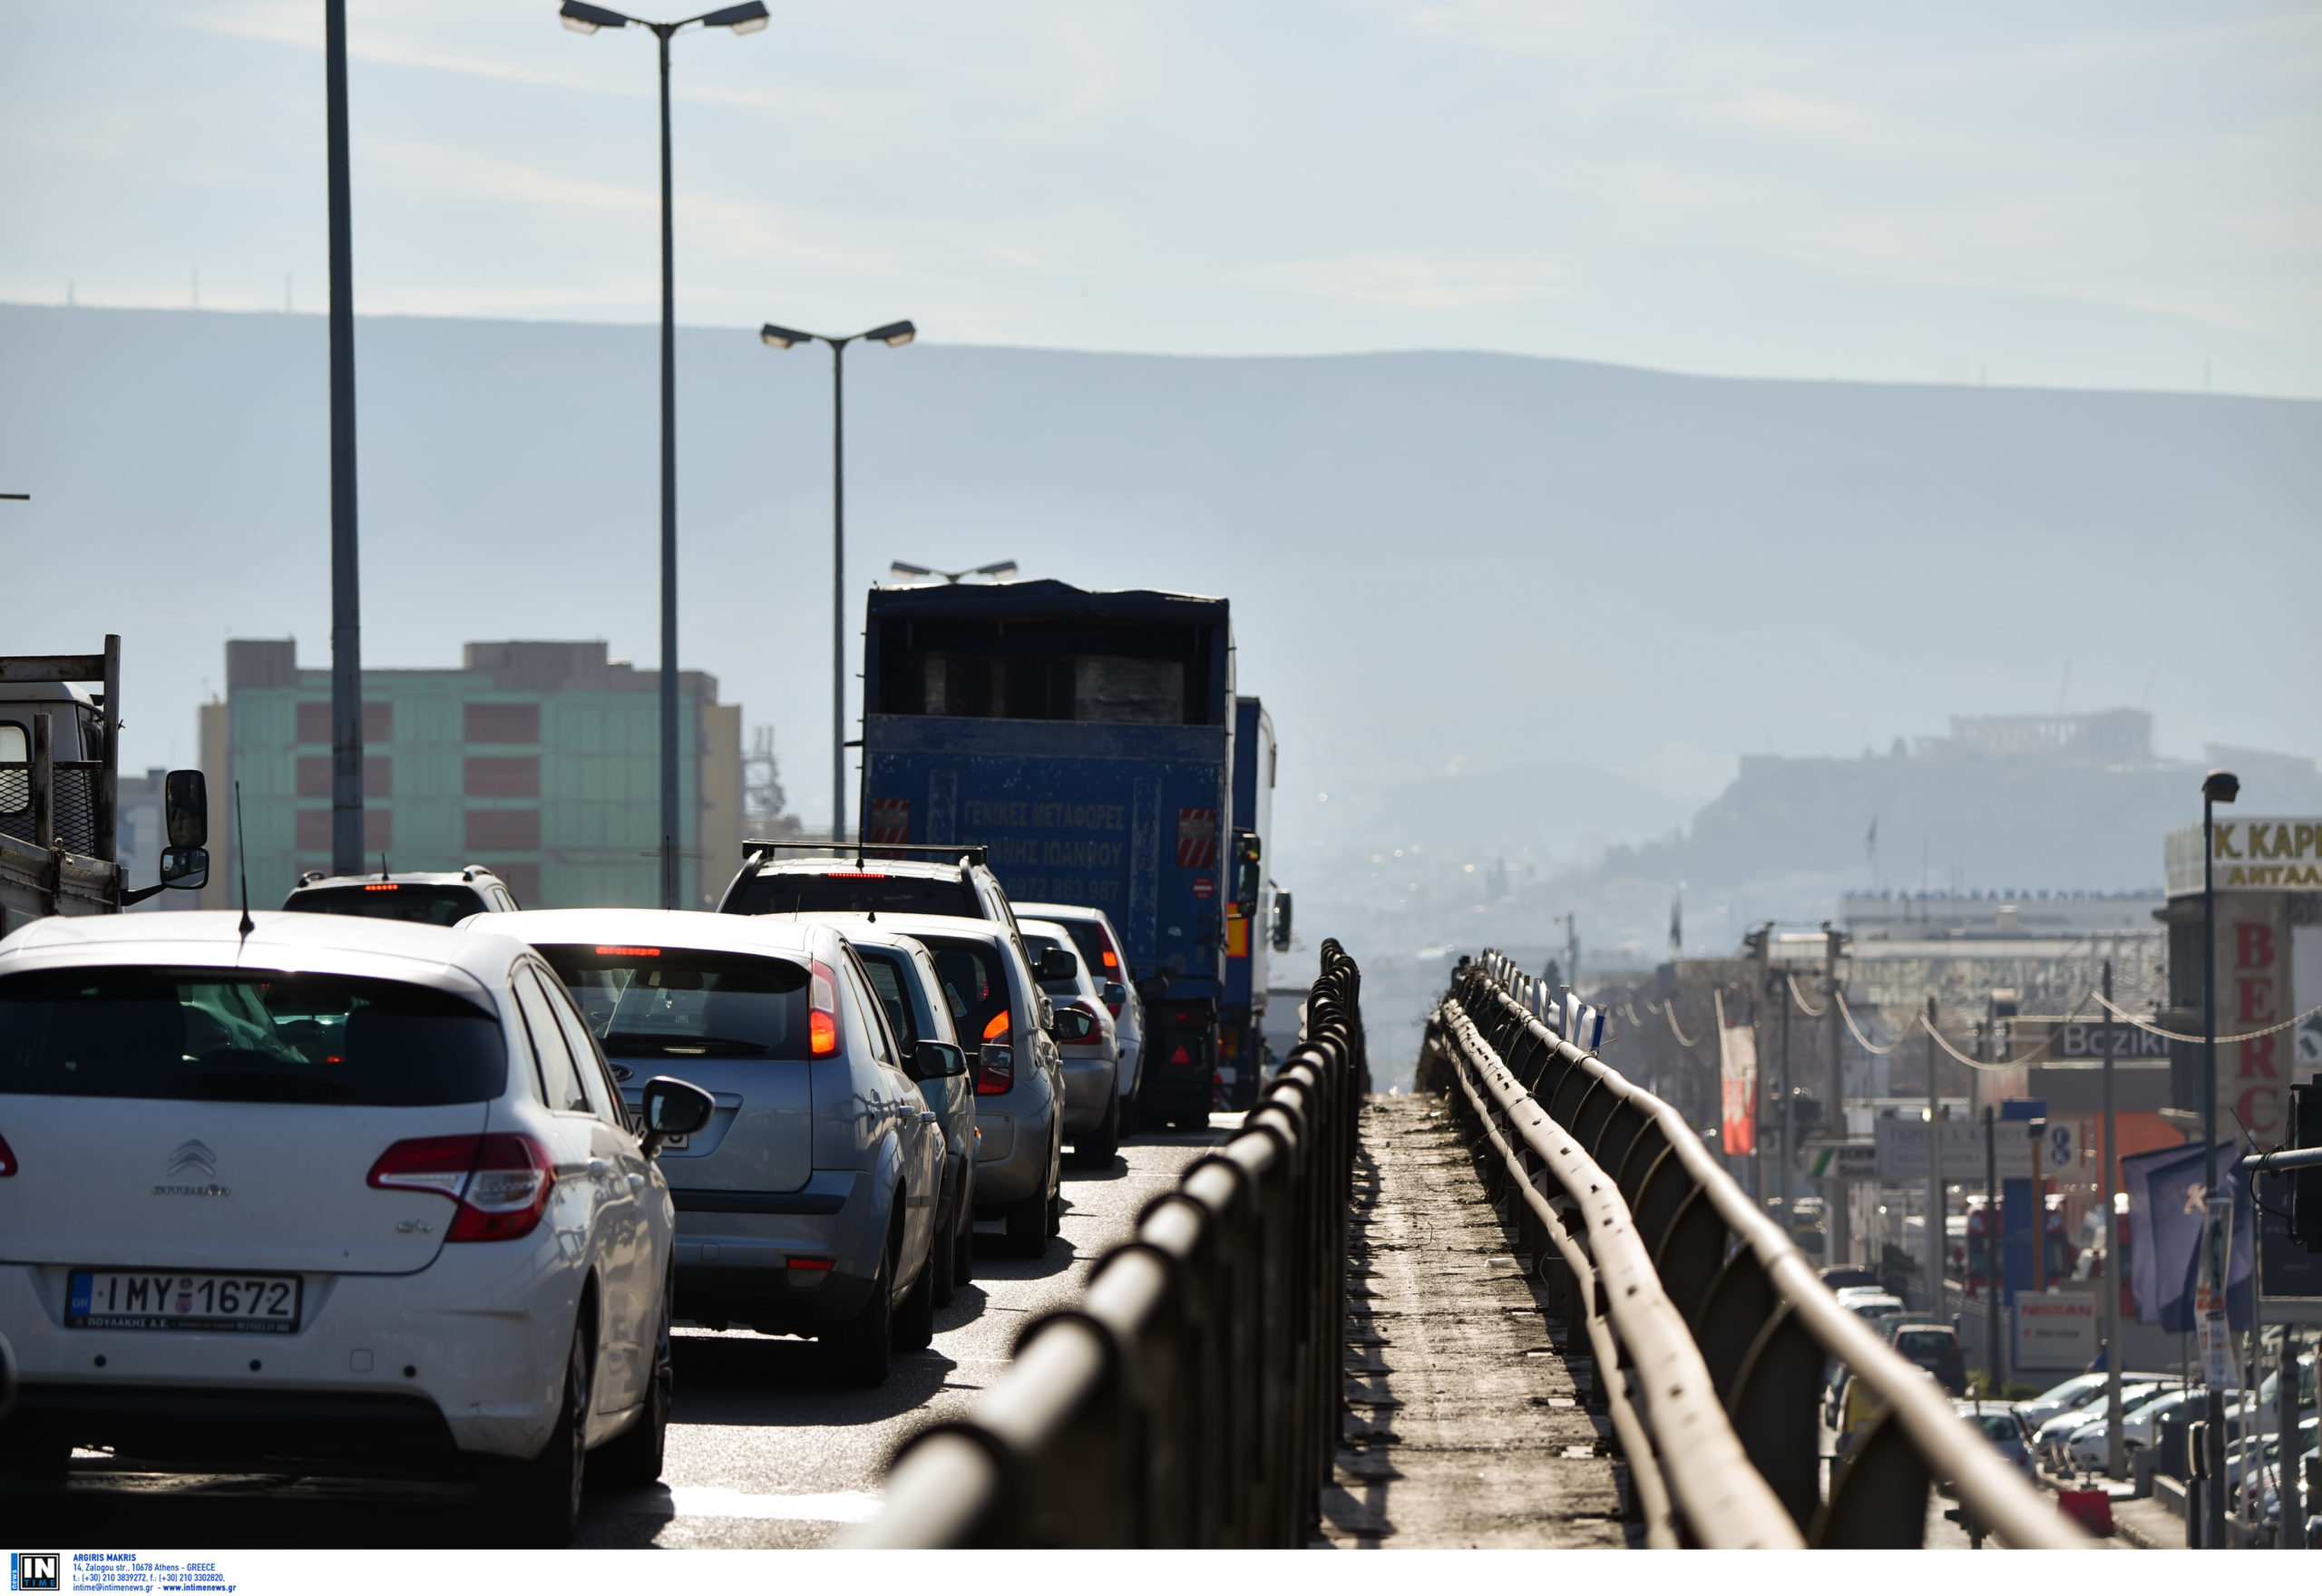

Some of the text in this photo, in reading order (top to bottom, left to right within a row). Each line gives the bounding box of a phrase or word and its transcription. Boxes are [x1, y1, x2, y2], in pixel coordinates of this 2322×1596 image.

[963, 801, 1126, 831] ΓΕΝΙΚΕΣ ΜΕΤΑΦΟΡΕΣ
[2228, 866, 2322, 886] ΑΝΤΑΛ
[1005, 876, 1121, 902] 6972 863 987
[2235, 921, 2278, 1153] BERC
[73, 1298, 89, 1309] GR
[2020, 1303, 2093, 1317] NISSAN
[88, 1318, 146, 1328] ΠΟΥΛΑΚΗΣ
